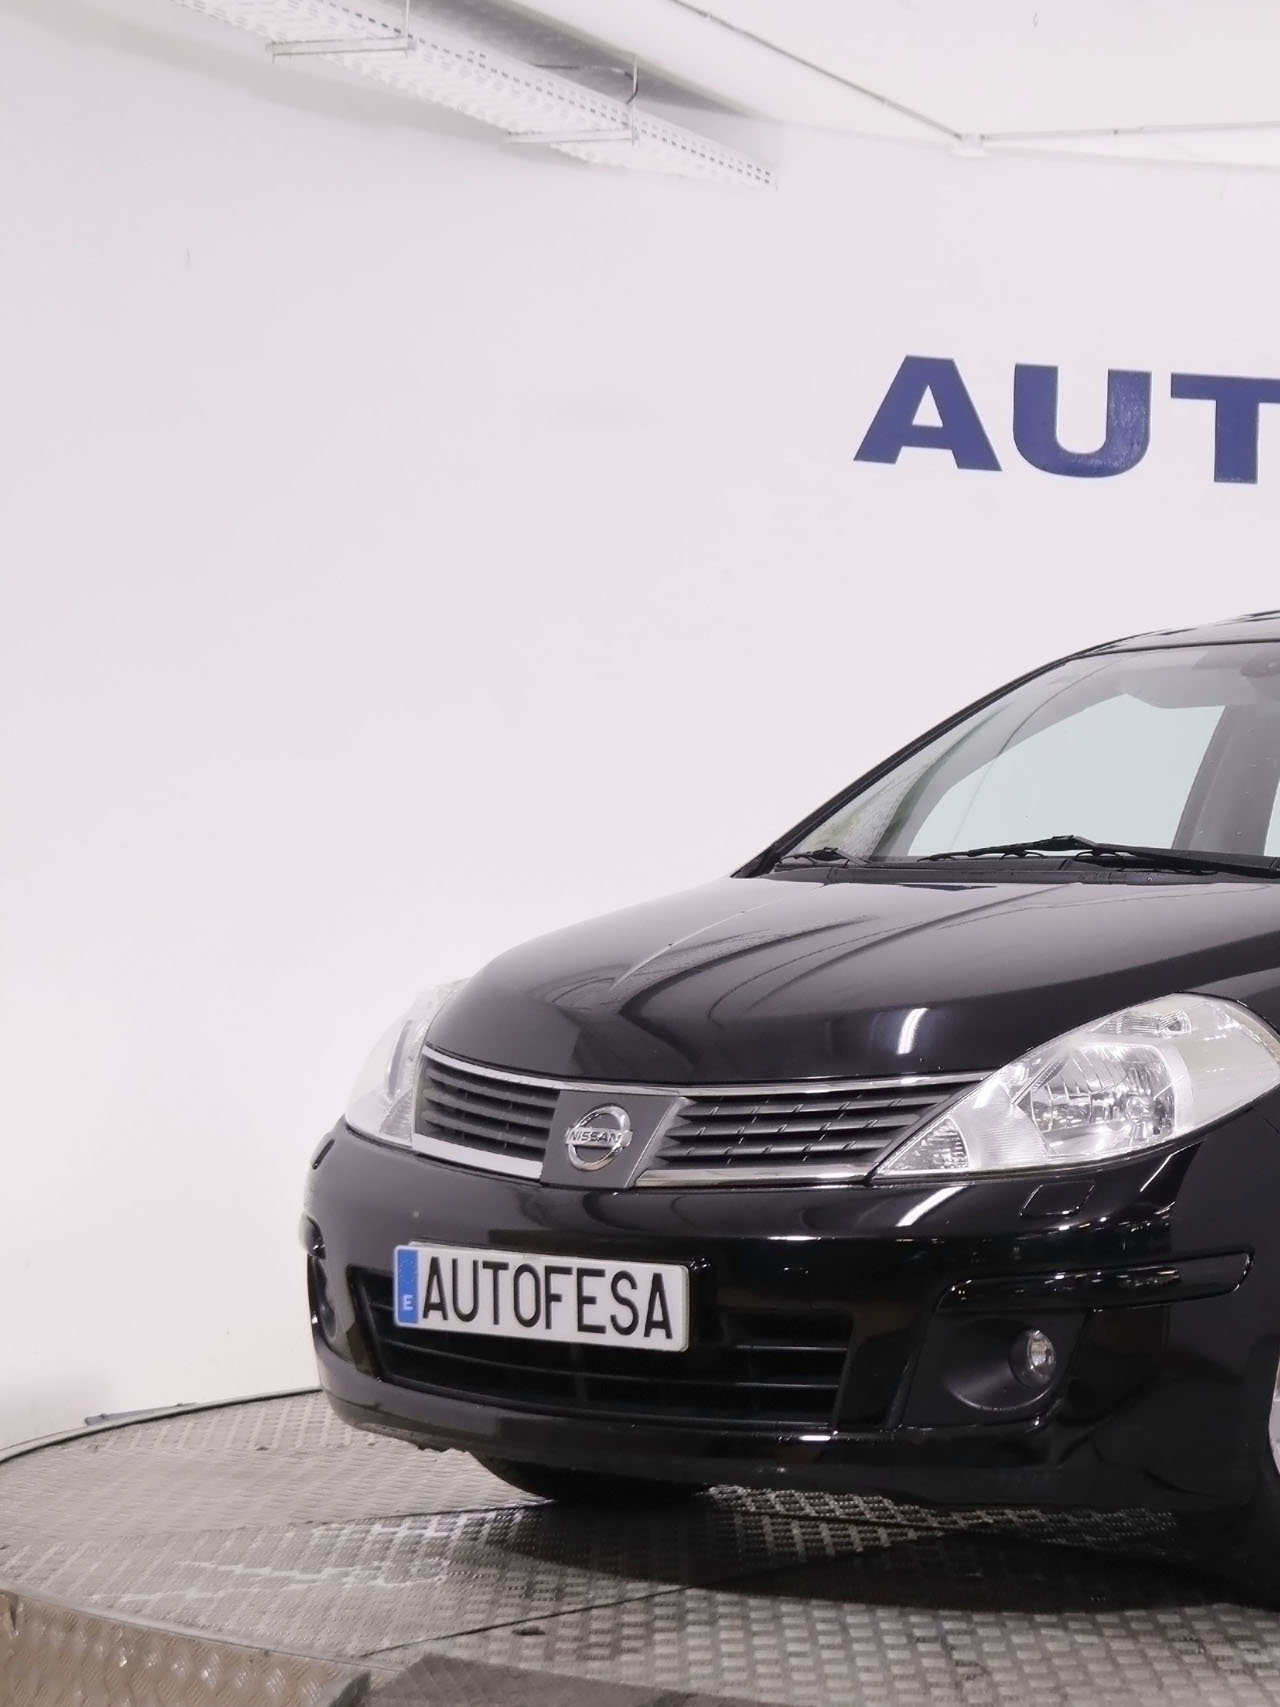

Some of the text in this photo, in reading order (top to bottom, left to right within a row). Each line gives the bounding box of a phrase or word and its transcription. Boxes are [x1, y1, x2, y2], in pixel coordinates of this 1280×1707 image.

[568, 1130, 622, 1143] NISSAN
[403, 1294, 414, 1311] E
[422, 1256, 673, 1340] AUTOFESA
